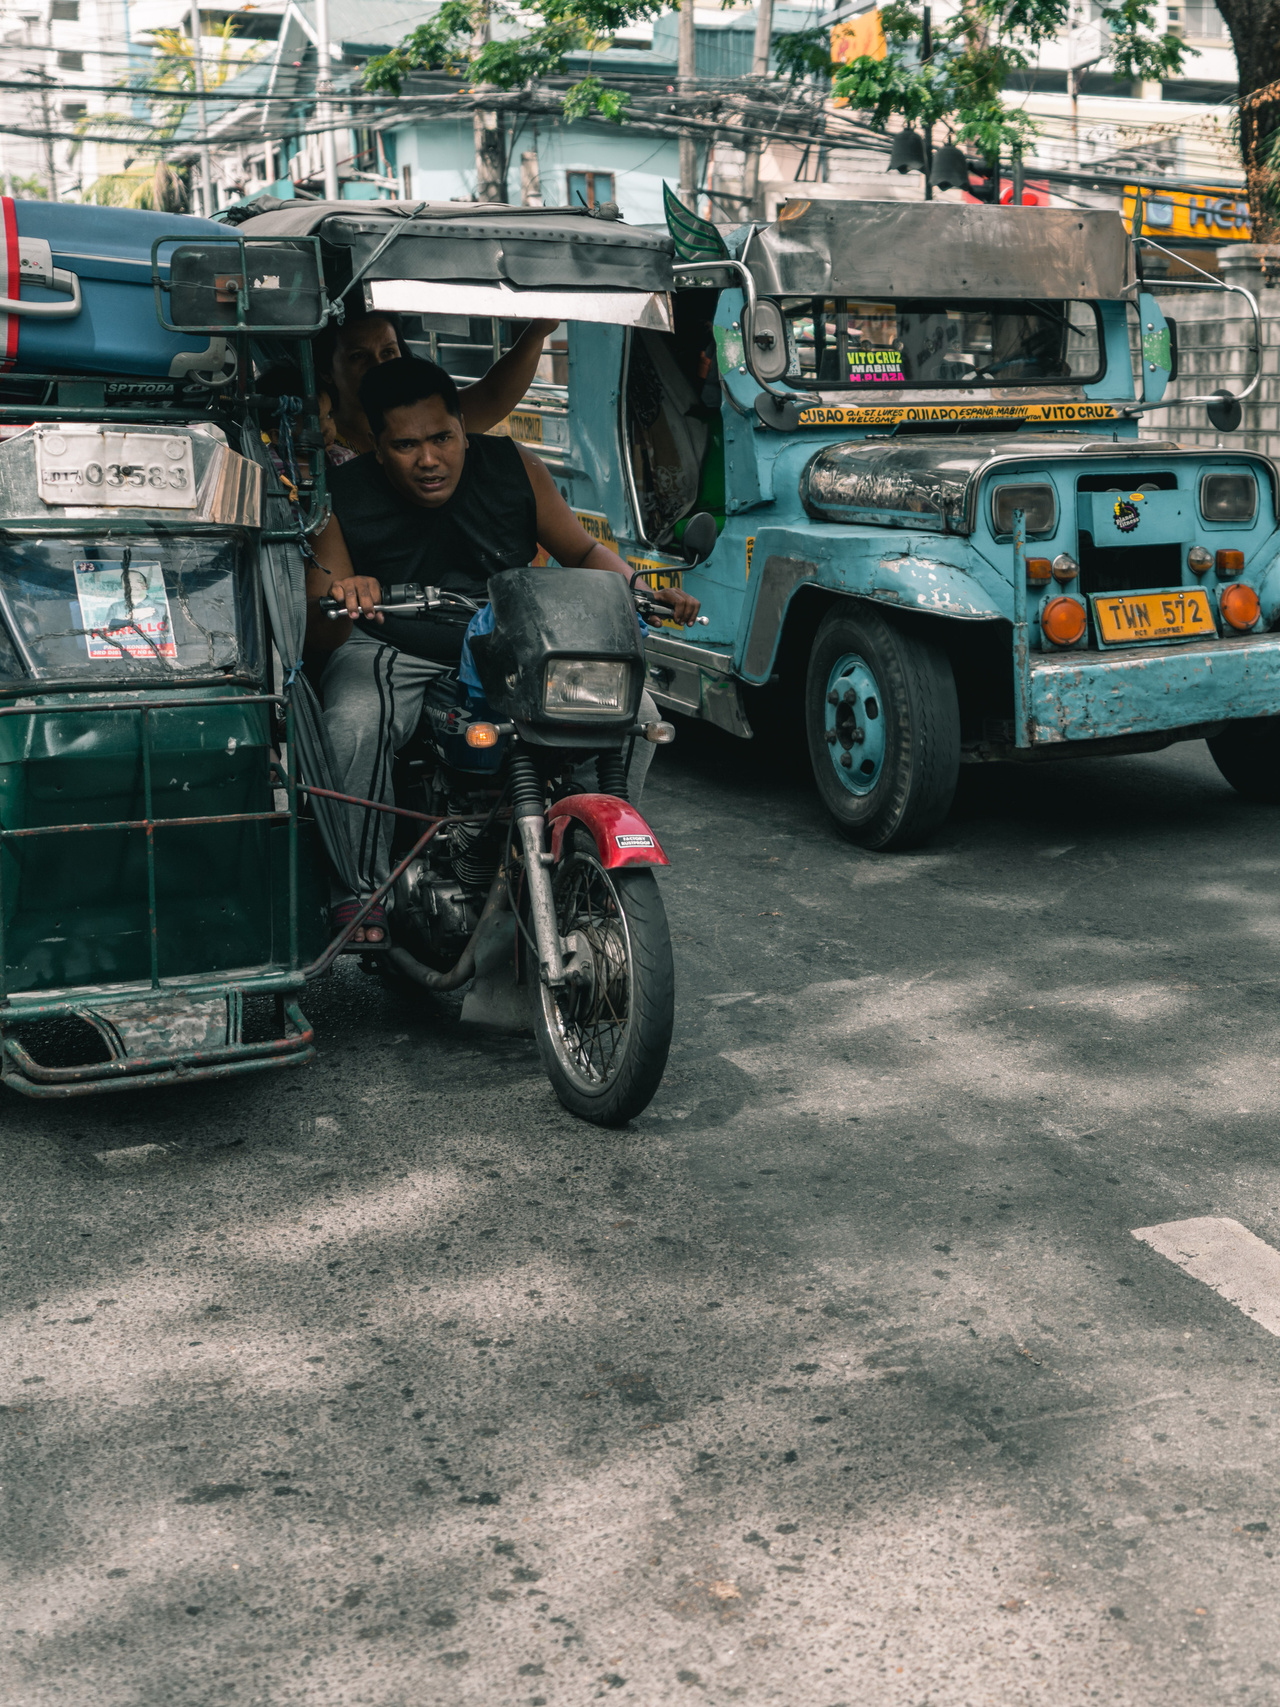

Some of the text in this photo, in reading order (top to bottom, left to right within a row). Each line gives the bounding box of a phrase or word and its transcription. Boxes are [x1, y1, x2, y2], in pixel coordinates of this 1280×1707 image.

[852, 364, 901, 373] MABINI
[800, 409, 844, 423] CUBAO
[878, 409, 904, 417] LUKES
[907, 408, 958, 421] QUIAPO
[1041, 406, 1075, 420] VITO
[1077, 405, 1115, 418] CRUZ
[848, 416, 896, 424] WELCOME
[86, 463, 188, 489] 03583
[1109, 599, 1203, 630] TWN 572
